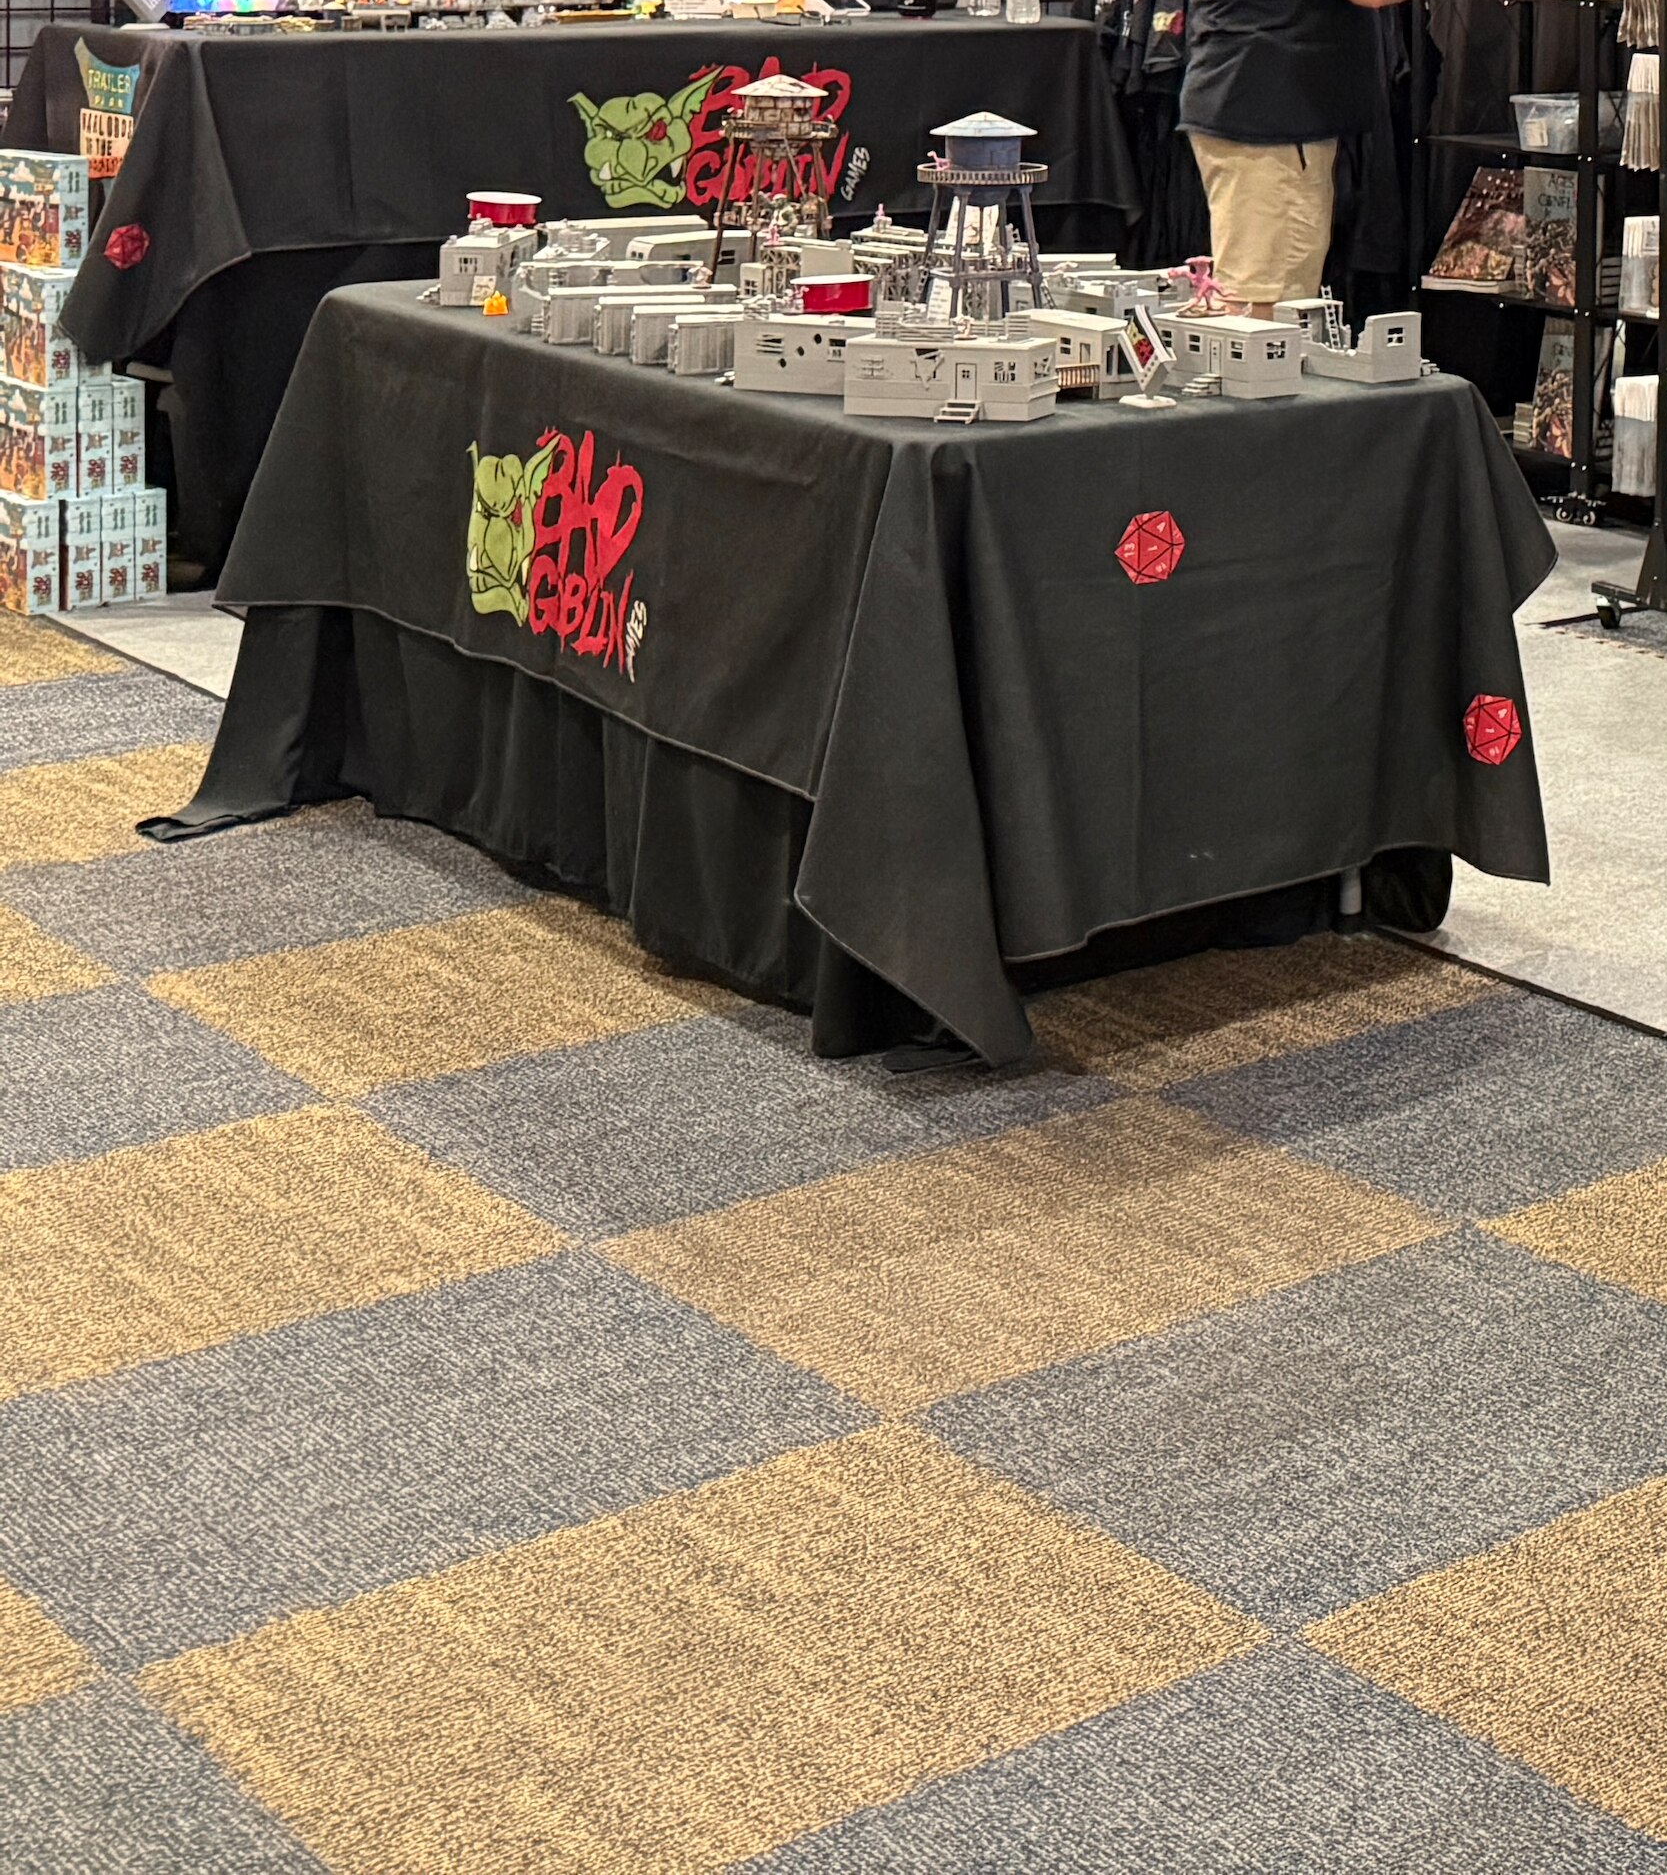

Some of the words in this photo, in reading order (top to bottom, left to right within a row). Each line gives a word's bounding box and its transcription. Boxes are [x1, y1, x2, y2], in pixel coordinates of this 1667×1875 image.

[88, 69, 131, 94] TRAILER
[687, 56, 852, 151] BD
[840, 146, 871, 202] GAMES
[1537, 192, 1573, 210] CONFL
[534, 425, 644, 587] BAD
[529, 554, 634, 676] GBLIN
